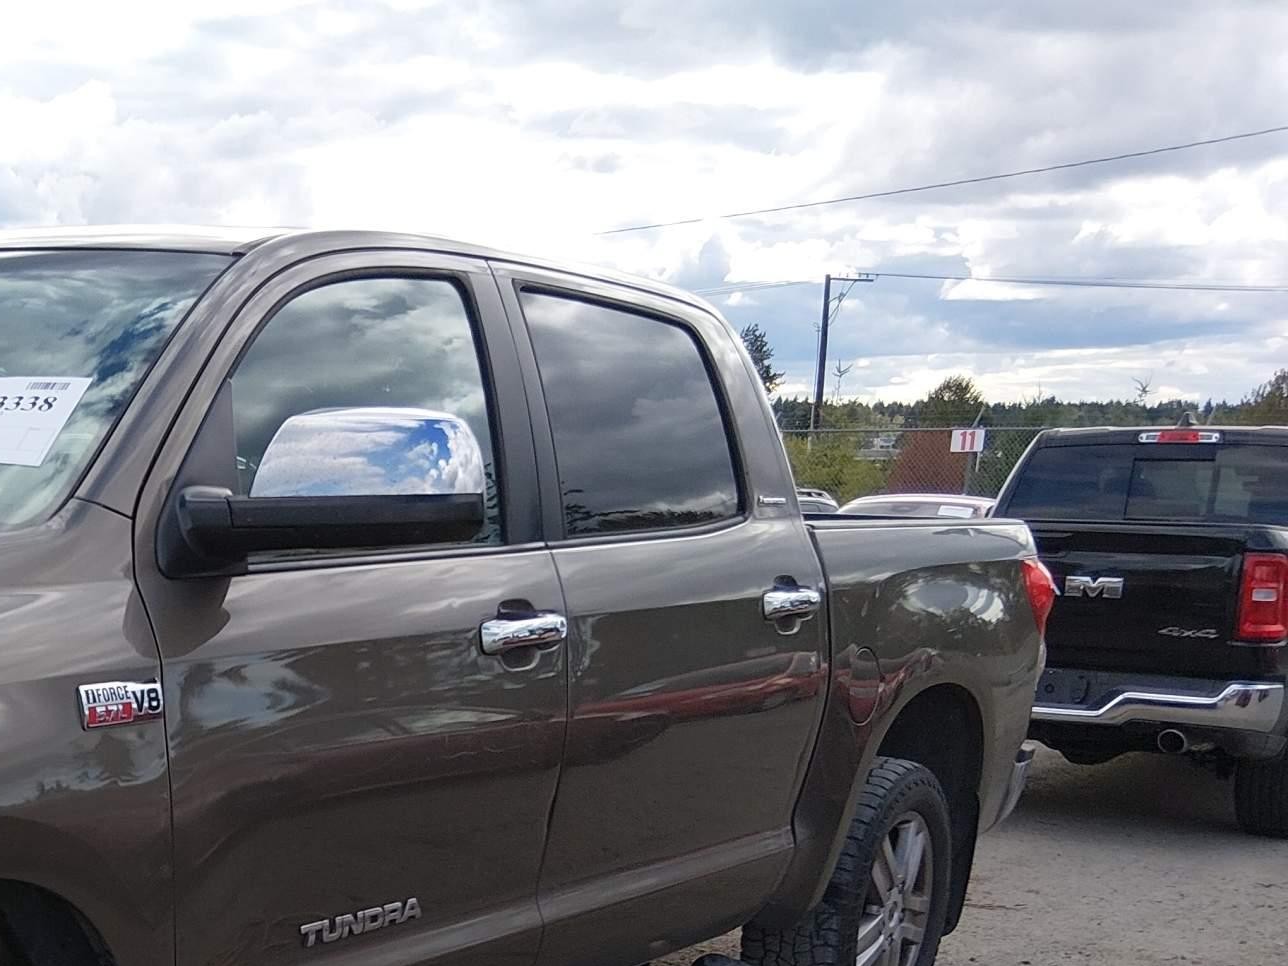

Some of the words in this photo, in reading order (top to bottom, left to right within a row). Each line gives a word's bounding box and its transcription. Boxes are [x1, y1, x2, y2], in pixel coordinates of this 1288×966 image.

[959, 430, 976, 451] 11
[132, 687, 161, 713] V8
[300, 897, 422, 947] TUNDRA
